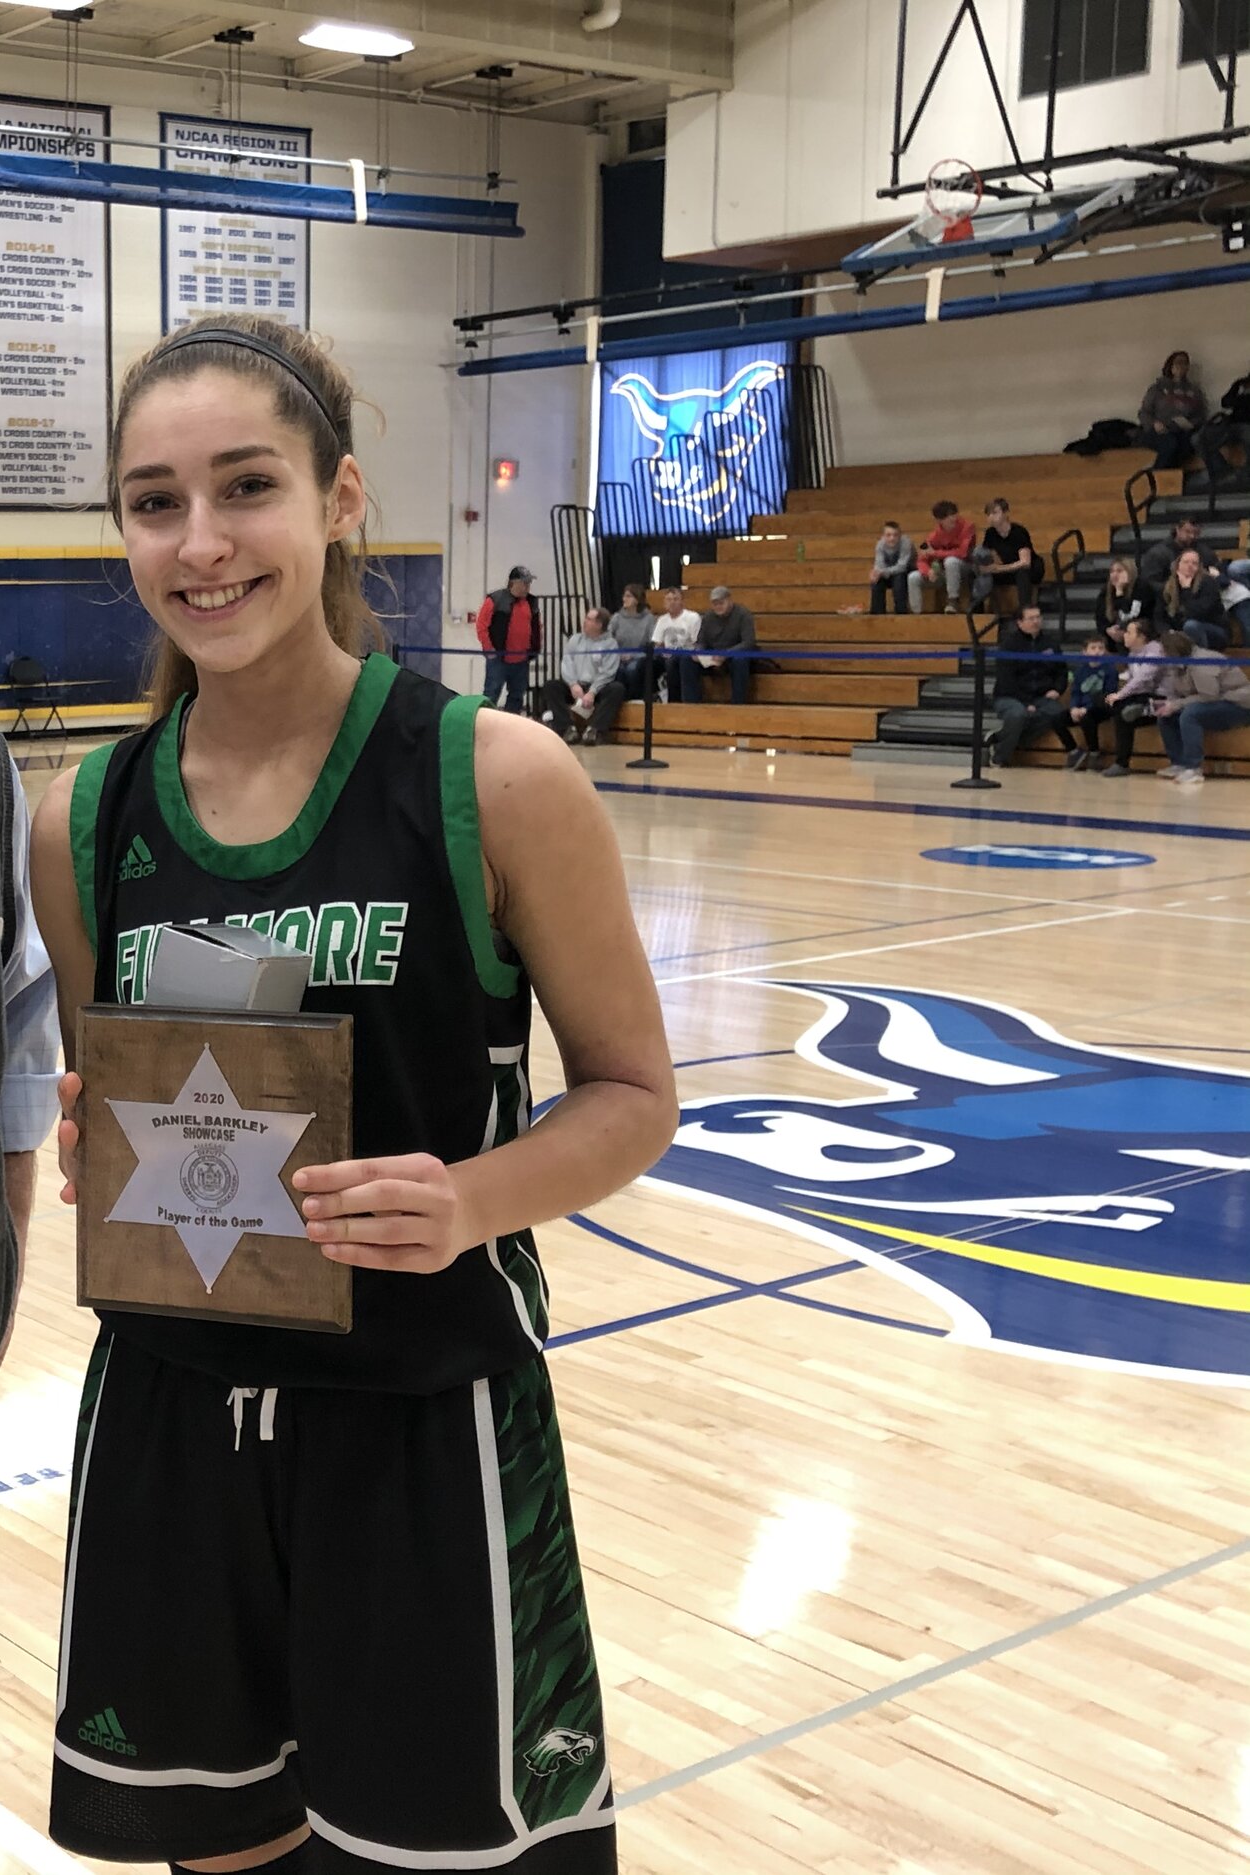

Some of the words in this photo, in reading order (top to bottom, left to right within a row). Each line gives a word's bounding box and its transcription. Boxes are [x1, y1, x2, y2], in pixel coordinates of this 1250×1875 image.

[175, 129, 219, 144] NJCAA
[223, 135, 275, 150] REGION
[279, 140, 298, 152] III
[175, 147, 299, 169] CHAMIONS
[2, 253, 29, 262] CROSS
[30, 256, 65, 265] COUNTRY
[7, 265, 33, 275] CROSS
[35, 268, 70, 277] COUNTRY
[26, 278, 56, 287] SOCCER
[17, 301, 65, 311] BASKETBALL
[0, 312, 45, 321] WRESTLING
[4, 354, 30, 363] CROSS
[32, 355, 67, 364] COUNTRY
[27, 367, 56, 375] SOCCER
[0, 377, 46, 386] VOLLEYBALL
[1, 388, 47, 397] WRESTLING
[4, 429, 30, 438] CROSS
[32, 431, 66, 439] COUNTRY
[9, 441, 34, 450] CROSS
[36, 442, 72, 450] COUNTRY
[28, 453, 57, 461] SOCCER
[2, 464, 47, 472] VOLLEYBALL
[19, 475, 66, 484] BASKETBALL
[1, 486, 46, 495] WRESTLING
[119, 861, 157, 881] didas
[116, 901, 409, 1004] FIORE
[194, 1092, 224, 1104] 2020
[152, 1115, 200, 1128] DANIEL
[204, 1116, 269, 1134] BARKLEY
[183, 1127, 235, 1142] SHOWCASE
[157, 1206, 191, 1225] Player
[194, 1215, 206, 1225] of
[209, 1216, 228, 1227] the
[231, 1217, 264, 1228] Game
[78, 1728, 138, 1757] adidas
